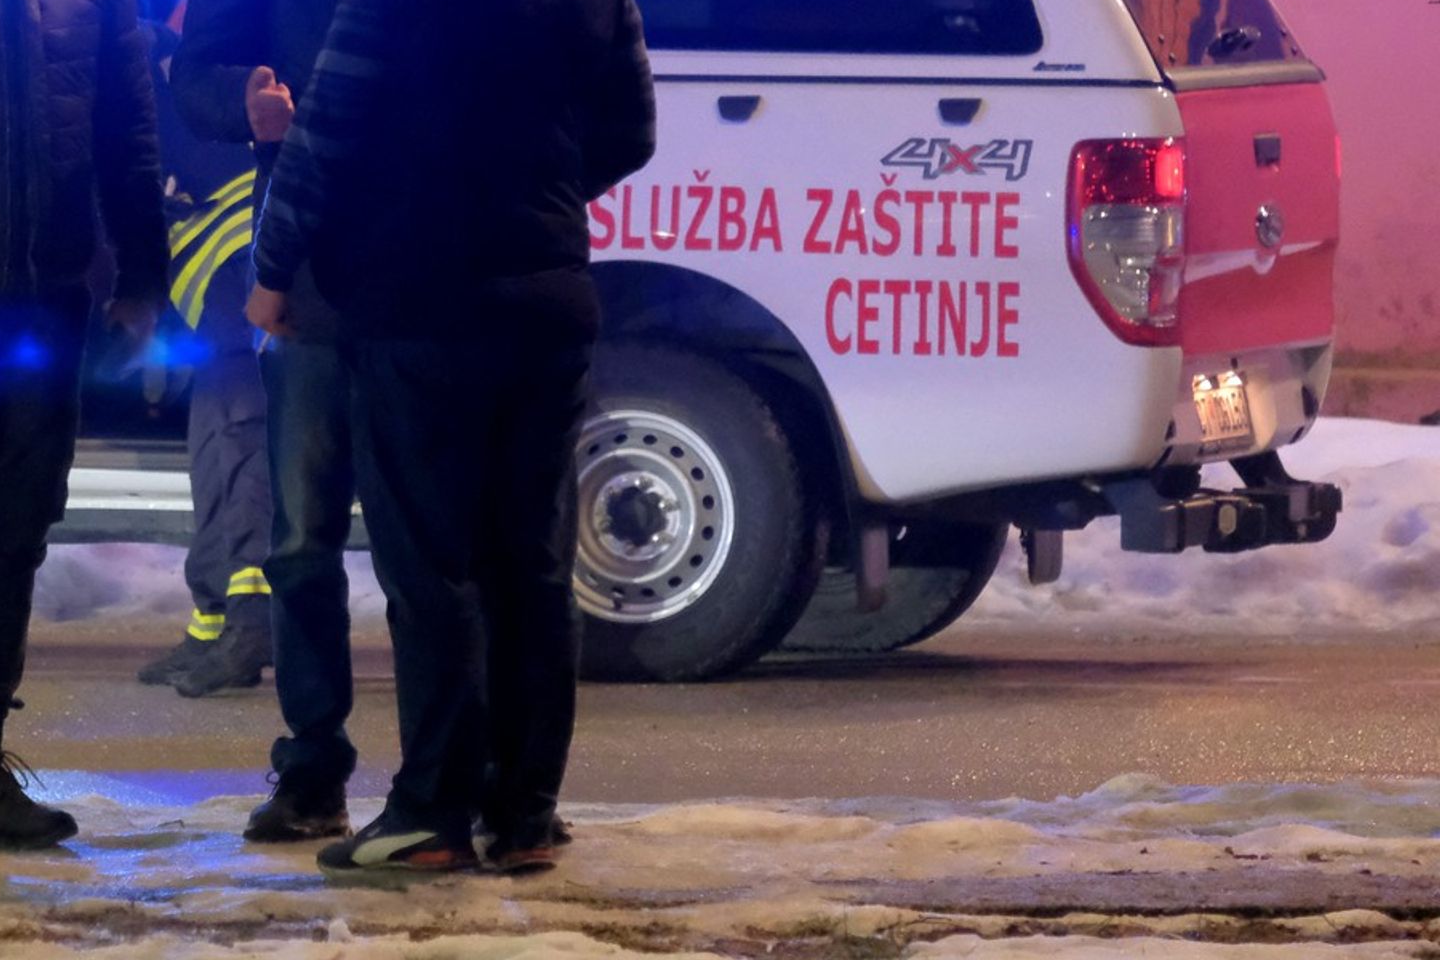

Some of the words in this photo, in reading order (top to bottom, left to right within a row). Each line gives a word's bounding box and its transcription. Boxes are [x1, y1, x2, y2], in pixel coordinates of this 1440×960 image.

[586, 170, 783, 252] SLUŽBA
[803, 173, 1020, 258] ZAŠTITE
[825, 277, 1020, 358] CETINJE
